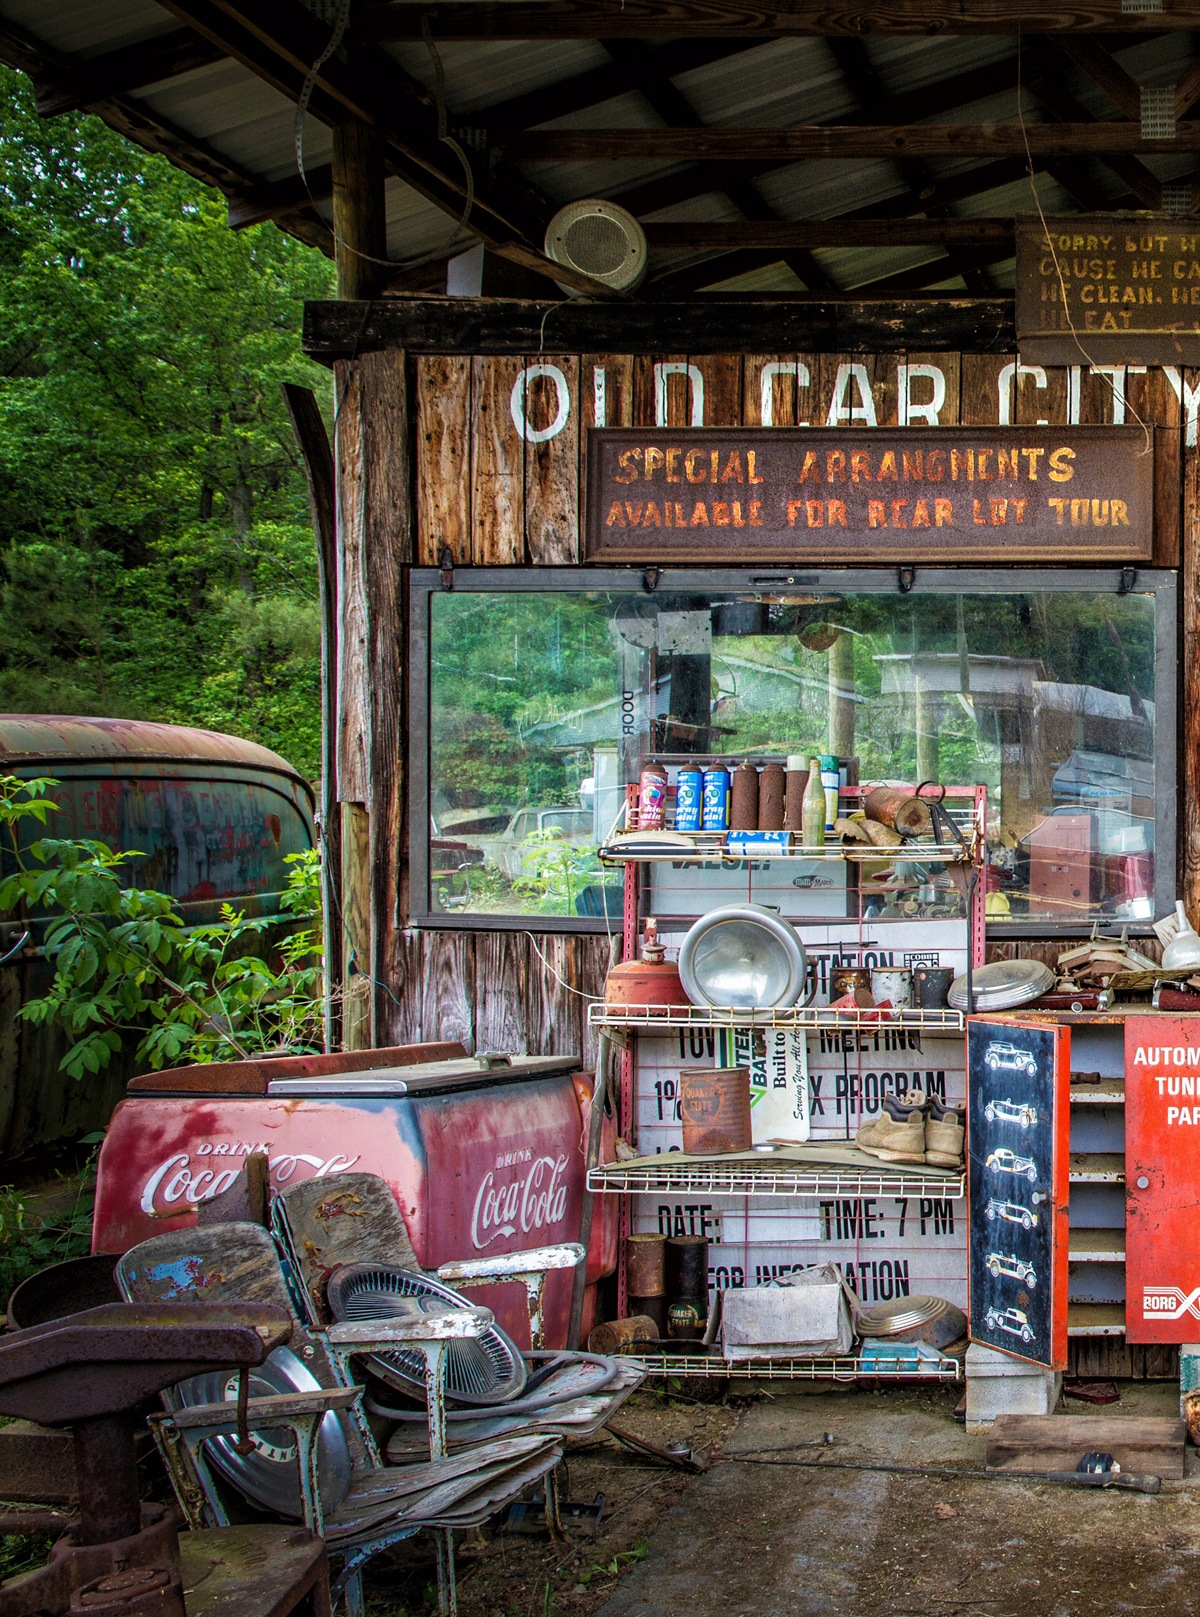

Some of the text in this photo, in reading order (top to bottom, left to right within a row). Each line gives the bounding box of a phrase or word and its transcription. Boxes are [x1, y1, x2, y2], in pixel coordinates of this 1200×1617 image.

[1040, 257, 1116, 280] CAUSE
[1132, 260, 1162, 279] WE
[1085, 310, 1133, 331] EAT
[511, 362, 704, 443] OLD
[760, 362, 946, 427] CAR
[615, 446, 1077, 484] SPECIAL ARRANGMENTS
[605, 497, 1131, 529] AVAILABLE FOR REAR LOT TOUR
[773, 1031, 787, 1089] Built to
[791, 1063, 806, 1083] You
[791, 1083, 805, 1121] Serving
[195, 1141, 273, 1157] DRINK
[495, 1147, 533, 1170] DRINK
[820, 1199, 885, 1240] TIME:
[894, 1198, 908, 1237] 7
[919, 1197, 955, 1236] PM
[1143, 1296, 1177, 1310] BORG
